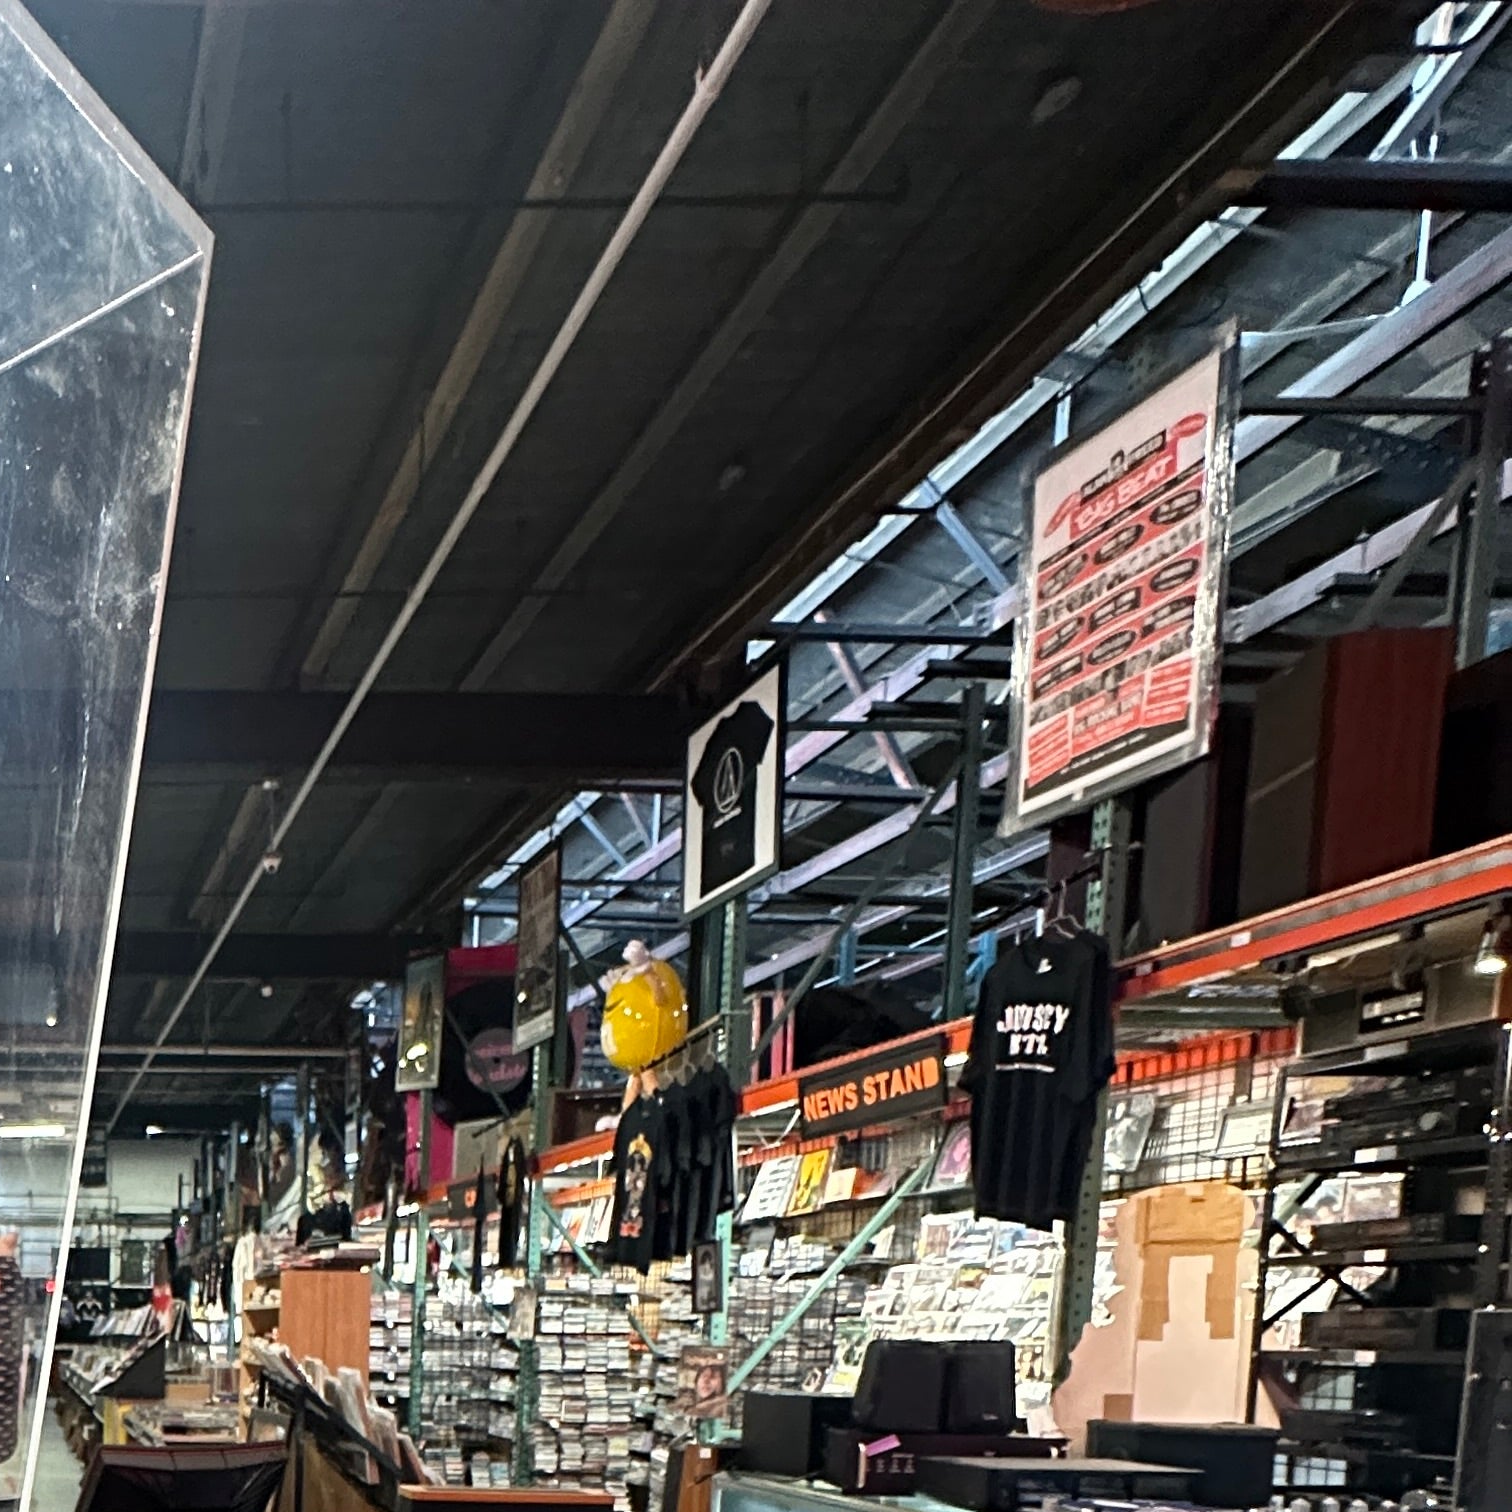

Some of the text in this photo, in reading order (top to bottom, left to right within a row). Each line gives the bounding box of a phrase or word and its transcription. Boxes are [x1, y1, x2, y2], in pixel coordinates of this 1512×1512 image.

[1117, 455, 1174, 503] BEAT
[803, 1056, 941, 1123] NEWS STAND
